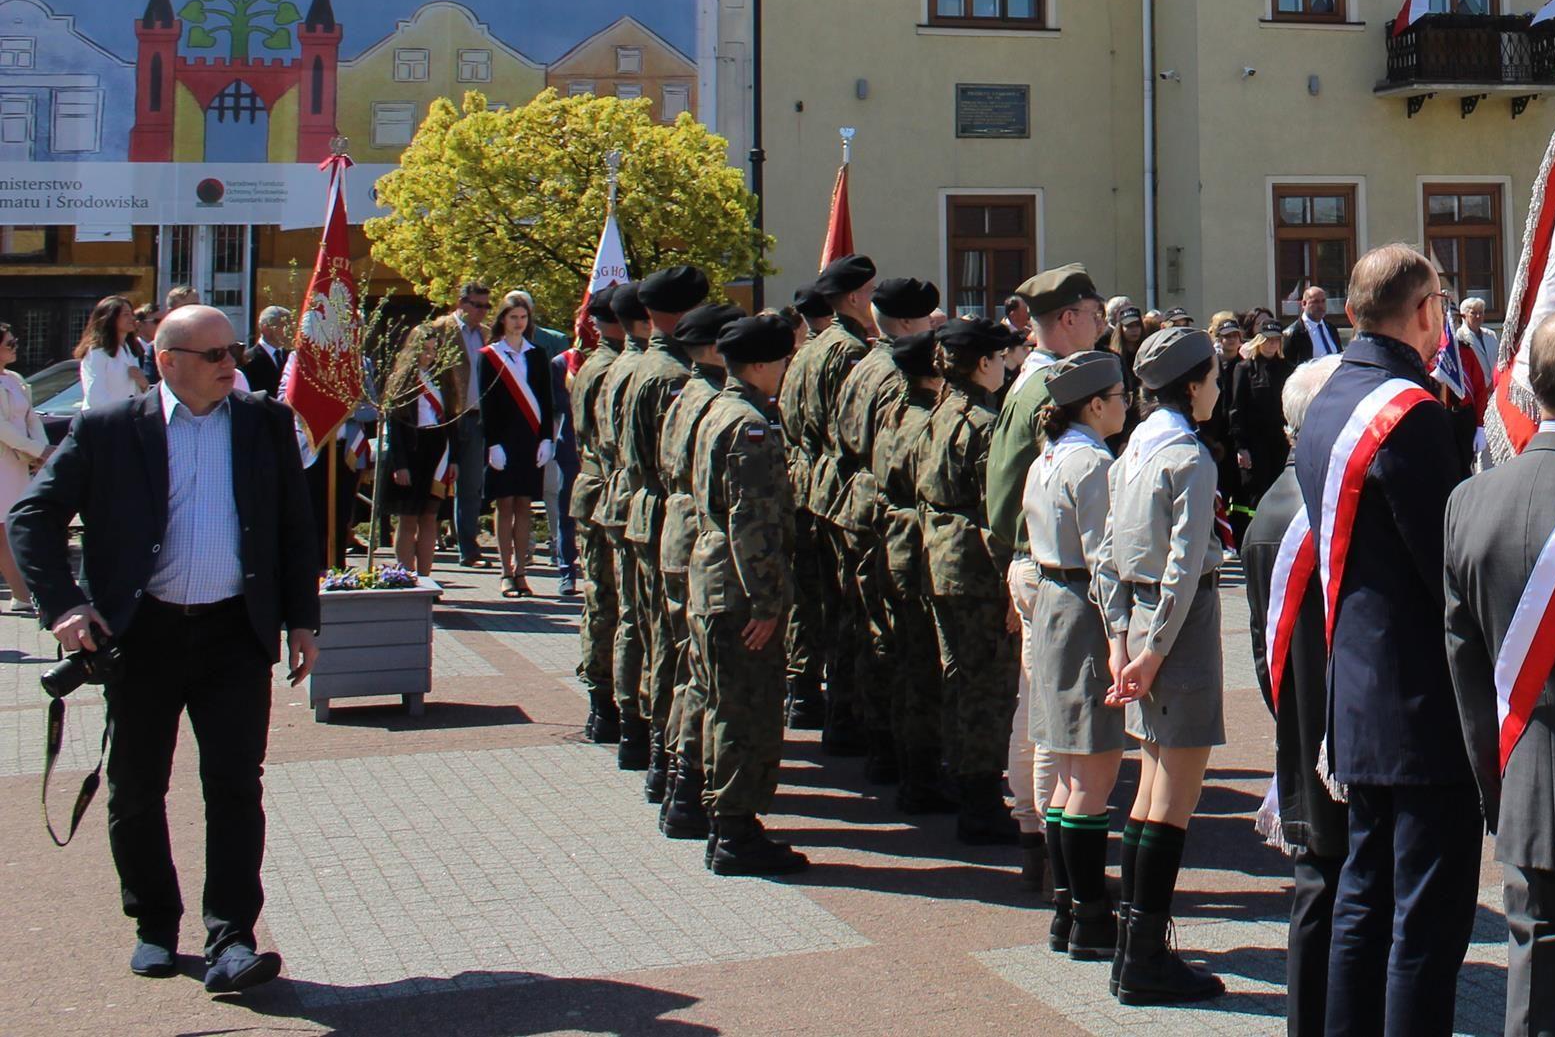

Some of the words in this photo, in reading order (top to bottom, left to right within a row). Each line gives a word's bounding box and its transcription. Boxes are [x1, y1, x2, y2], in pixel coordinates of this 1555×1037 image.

[0, 177, 82, 192] nisterstwo
[0, 196, 40, 209] matu
[46, 195, 52, 209] i
[56, 192, 150, 209] Środowiska
